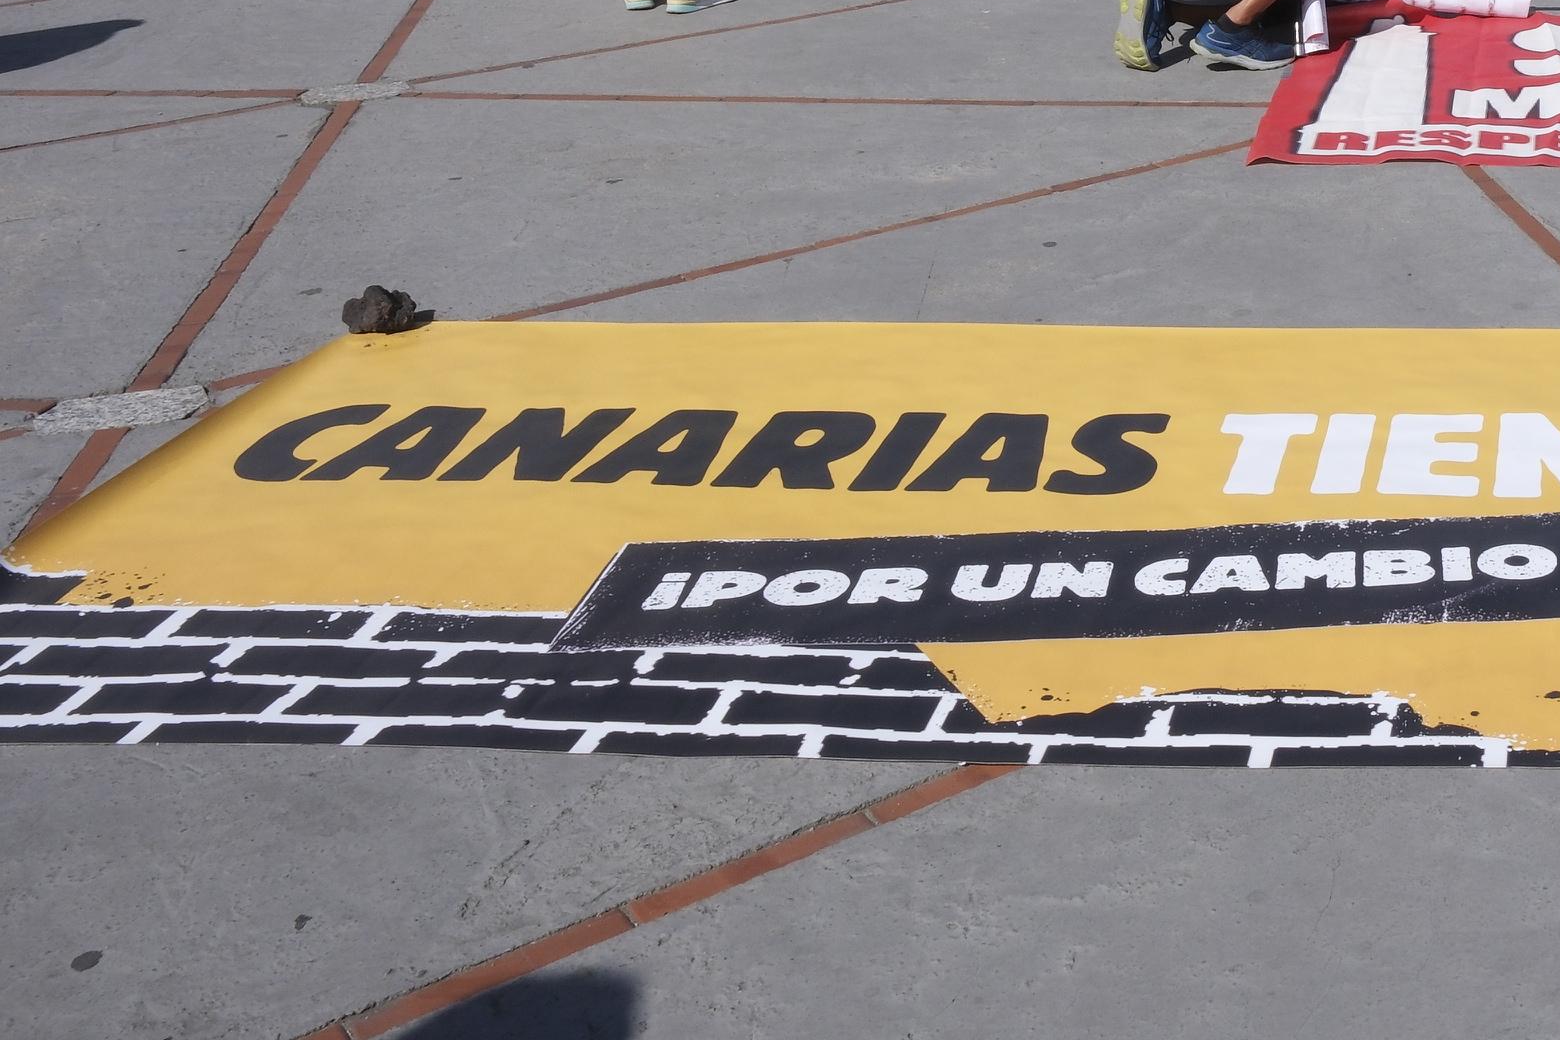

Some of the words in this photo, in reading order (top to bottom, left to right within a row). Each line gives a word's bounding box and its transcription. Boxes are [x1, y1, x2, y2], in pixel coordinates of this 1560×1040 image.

[233, 403, 1171, 495] CANARIAS
[640, 567, 929, 612] ¡POR
[950, 560, 1117, 602] UN
[1132, 542, 1558, 598] CAMBIO
